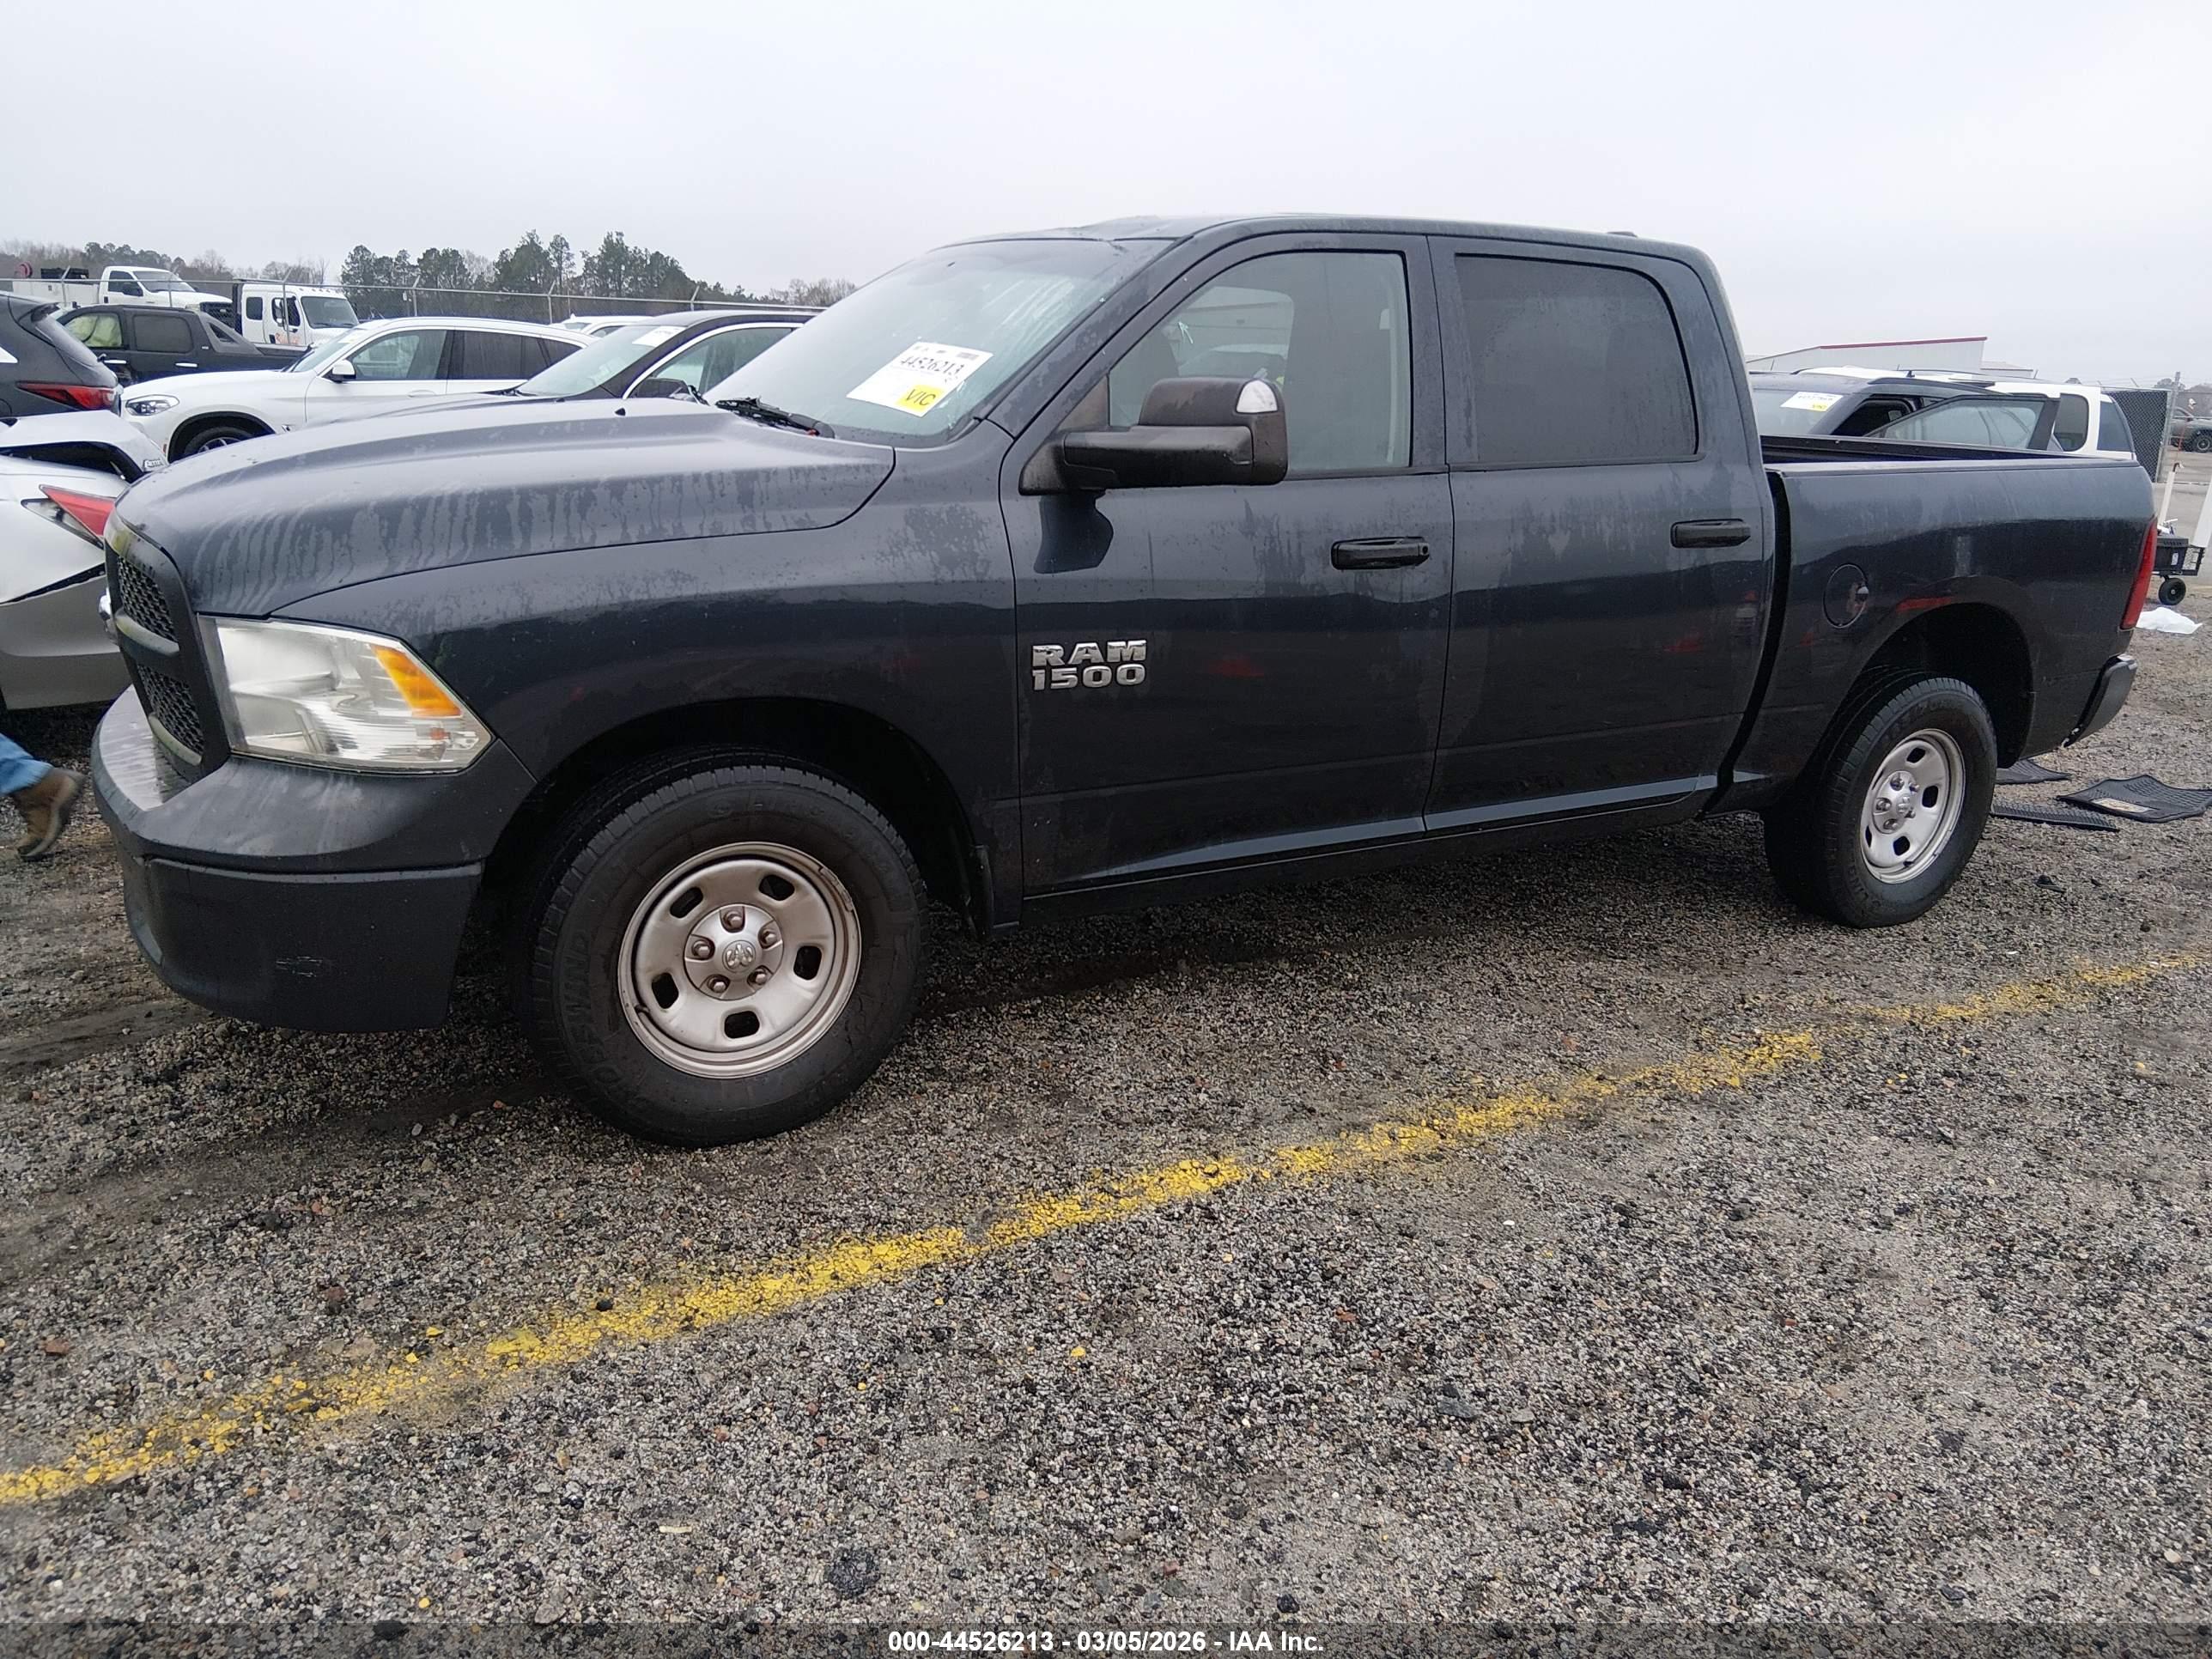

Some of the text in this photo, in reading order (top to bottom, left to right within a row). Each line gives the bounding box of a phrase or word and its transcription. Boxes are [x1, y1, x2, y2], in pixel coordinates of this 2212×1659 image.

[904, 389, 936, 406] VIC
[1032, 640, 1147, 667] RAM
[1032, 664, 1146, 690] 1500
